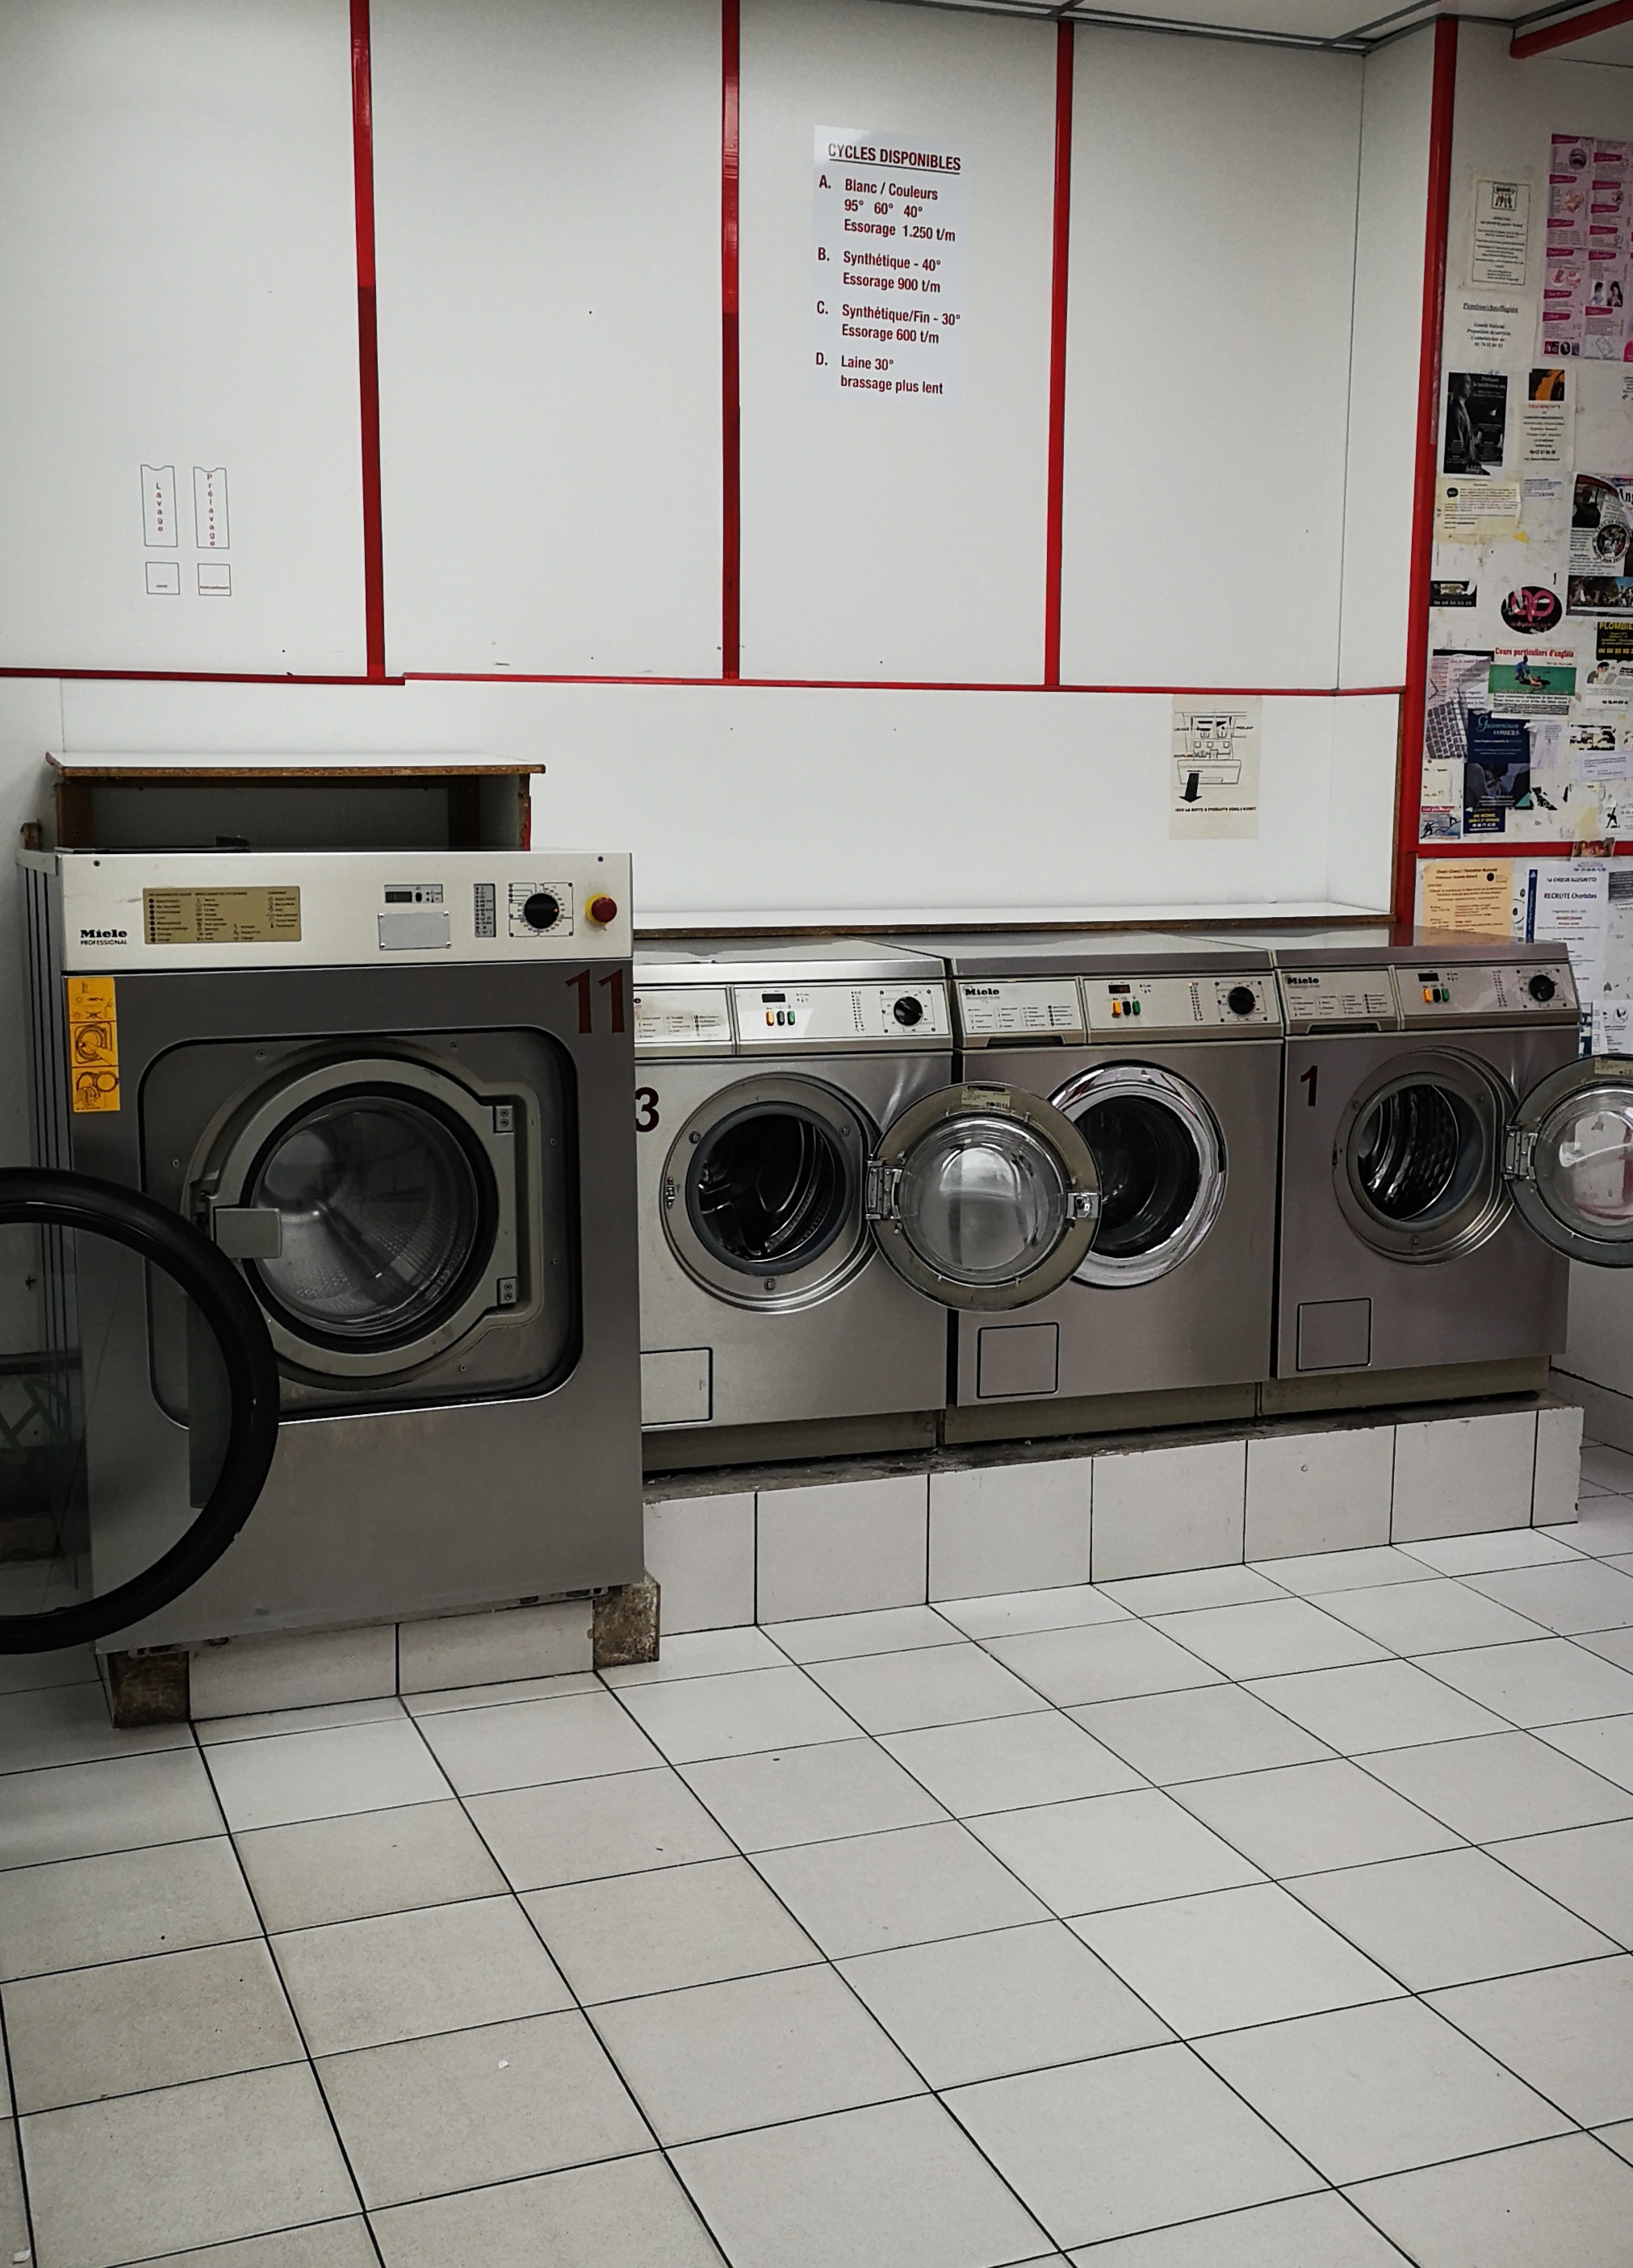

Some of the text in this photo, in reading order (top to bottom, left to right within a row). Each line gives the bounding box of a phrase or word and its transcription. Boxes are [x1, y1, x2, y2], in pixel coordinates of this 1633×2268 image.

[828, 143, 961, 170] CYCLES DISPONIBLES
[819, 175, 937, 200] A. Blanc / Couleurs
[844, 199, 923, 218] 95° 60° 40°
[844, 220, 956, 242] Essorage 1.250 t/m
[818, 248, 830, 262] B.
[844, 251, 911, 270] Synthétique
[922, 259, 940, 271] 40°
[843, 273, 940, 293] Essorage 900 t/m
[817, 301, 828, 315] C.
[842, 304, 930, 324] Synthétique/Fin
[942, 313, 960, 326] 30°
[842, 324, 939, 344] Essorage 600 t/m
[816, 353, 894, 370] D. Laine 30°
[840, 375, 943, 395] brassage plus lent
[1514, 648, 1547, 657] particuliers
[1549, 650, 1574, 659] d'anglais
[80, 929, 128, 938] Miele
[564, 969, 625, 1034] 11
[965, 988, 999, 996] Miele
[1300, 1065, 1318, 1107] 1
[634, 1086, 659, 1132] 3
